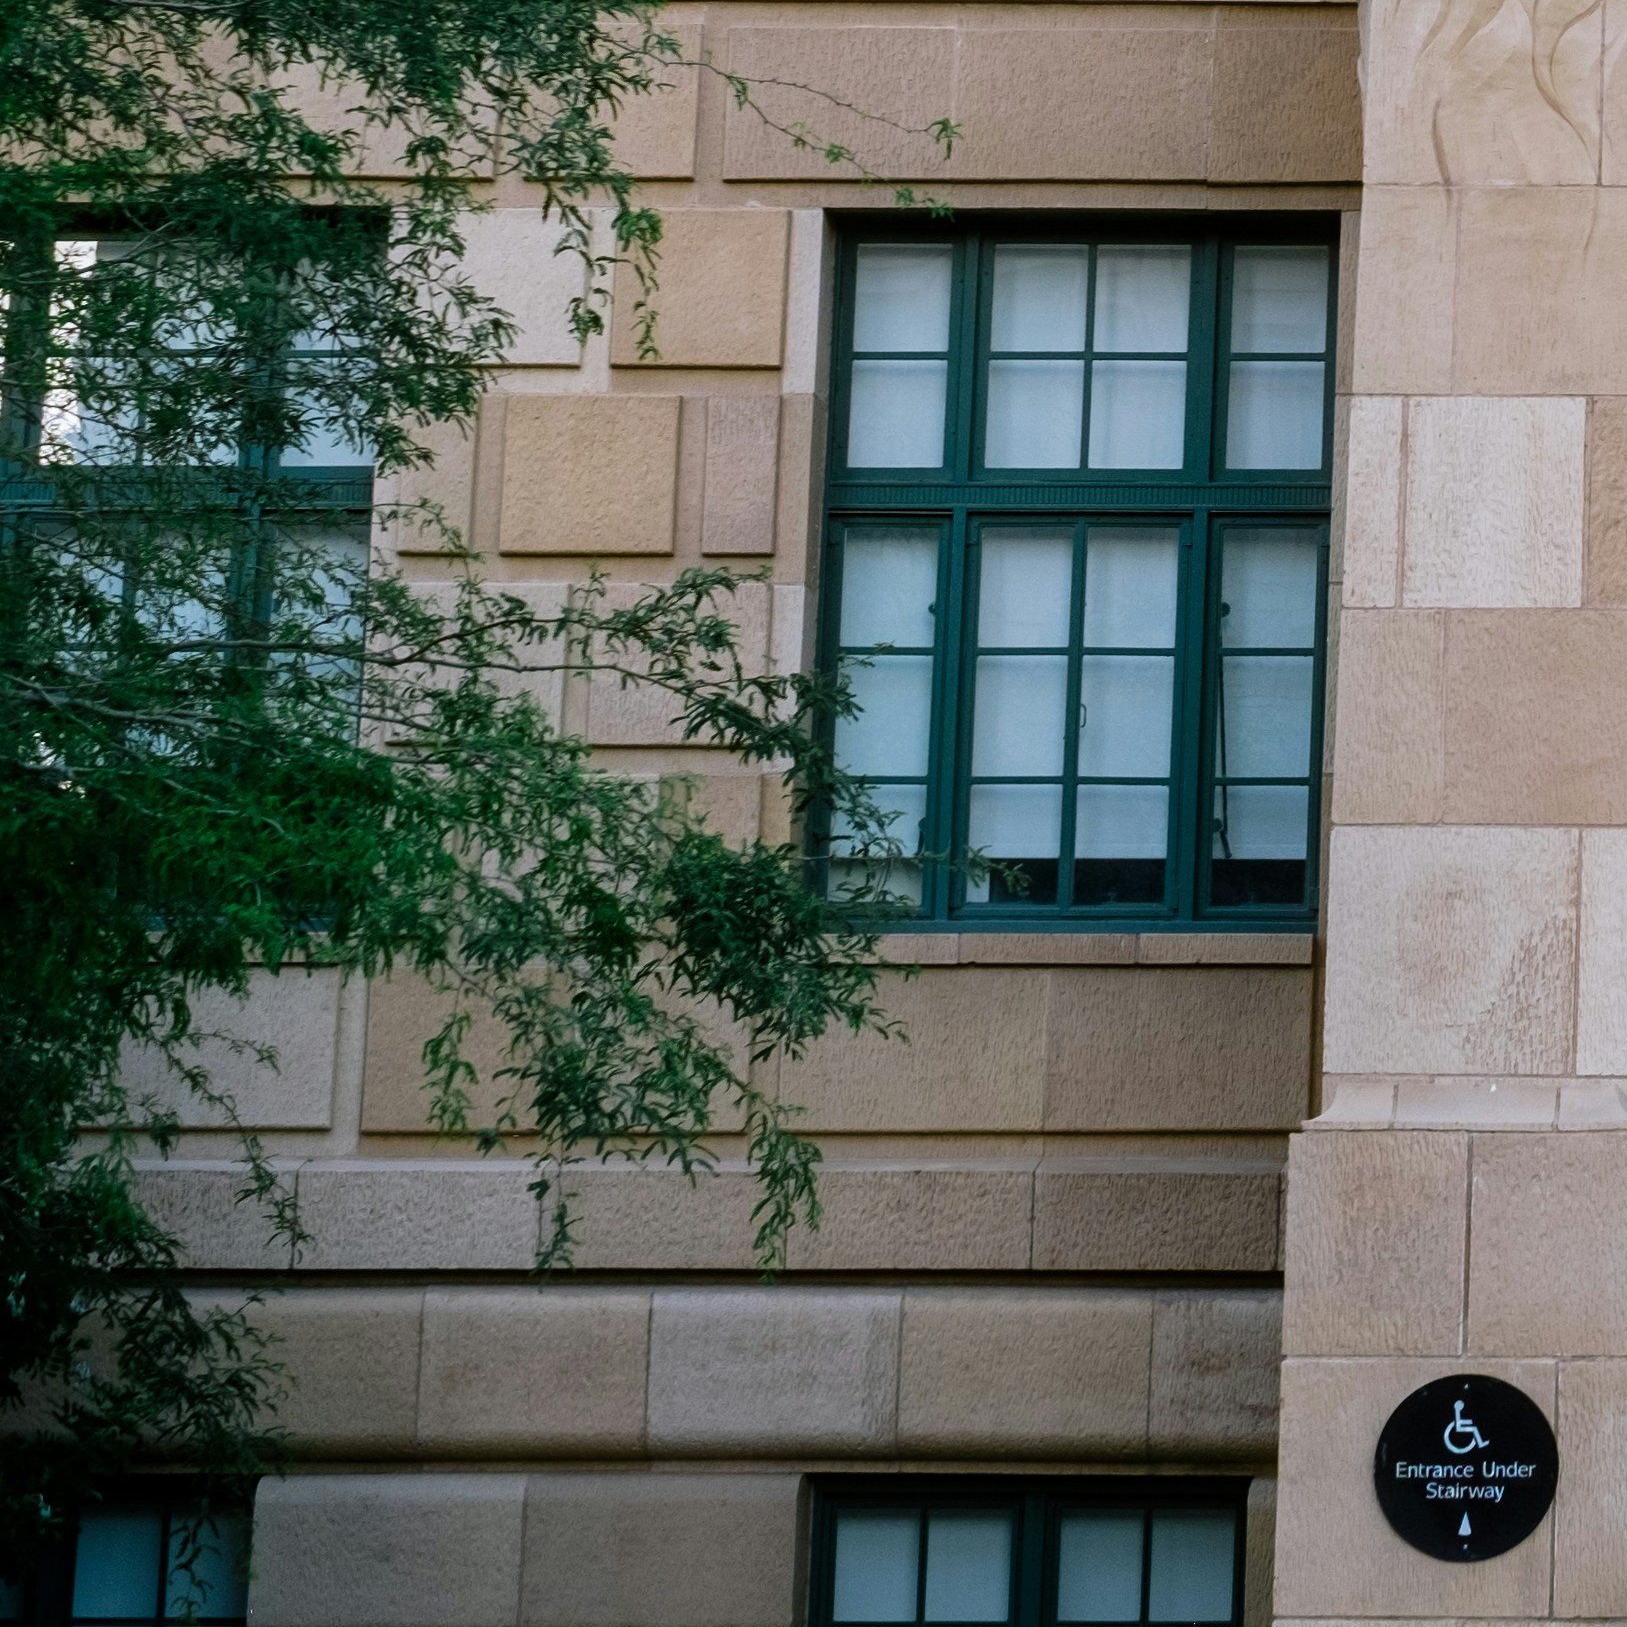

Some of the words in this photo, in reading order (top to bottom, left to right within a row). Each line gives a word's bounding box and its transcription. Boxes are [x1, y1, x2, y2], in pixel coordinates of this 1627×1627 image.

[1396, 1462, 1474, 1478] Entrance
[1482, 1461, 1536, 1478] Under
[1426, 1482, 1505, 1503] Stairway
